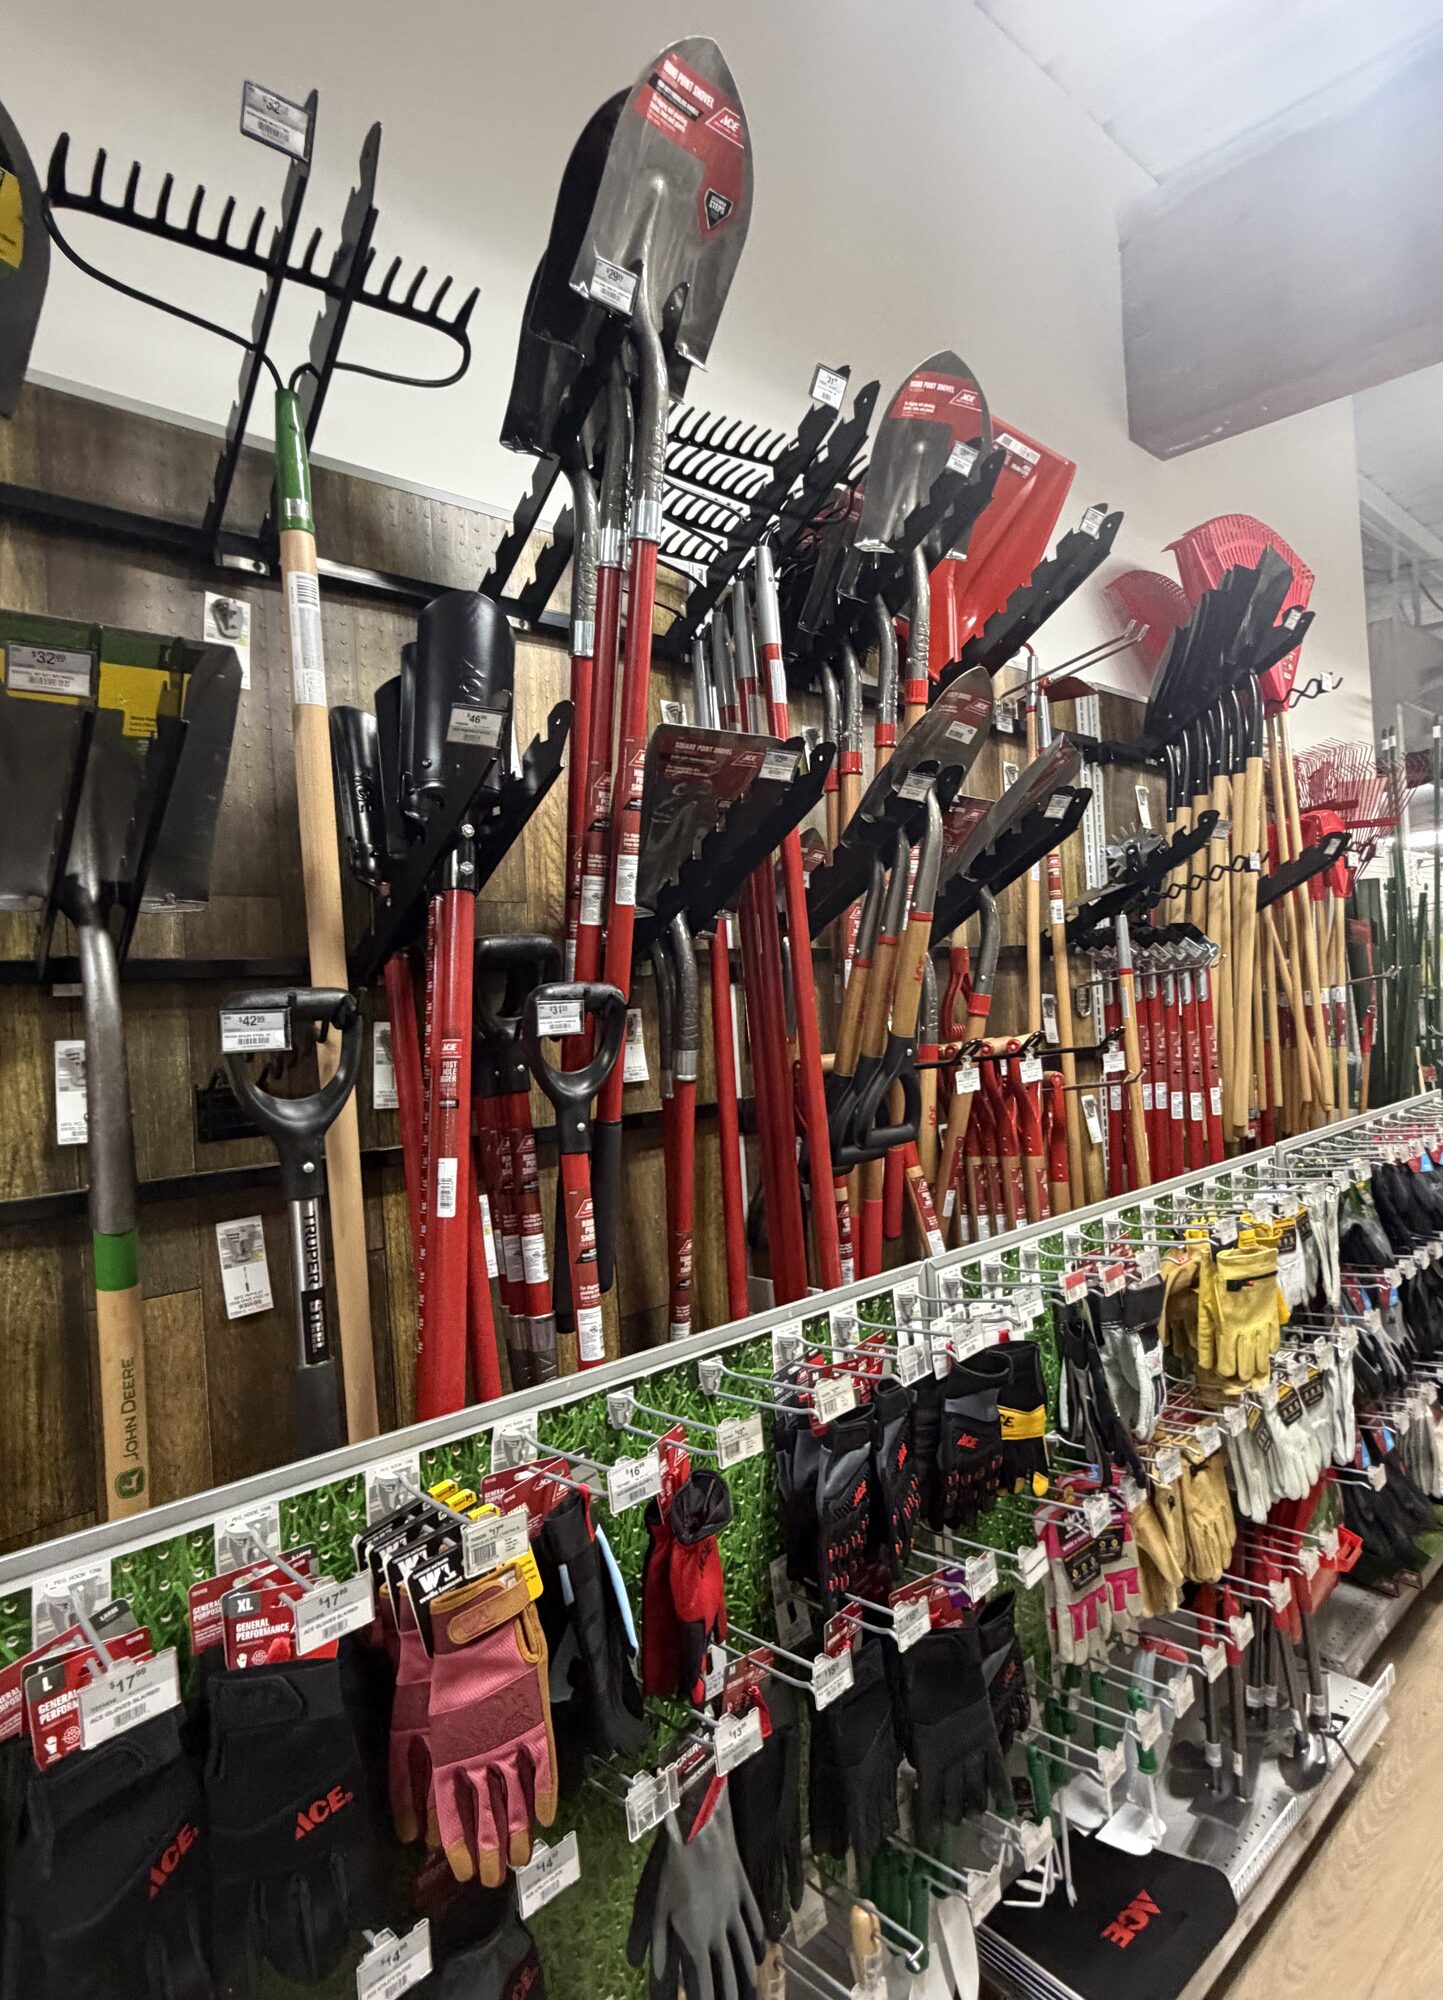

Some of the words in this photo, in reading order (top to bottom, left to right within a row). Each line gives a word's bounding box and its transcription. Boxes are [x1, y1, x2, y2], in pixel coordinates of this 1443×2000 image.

[719, 114, 741, 132] ACE
[442, 1043, 457, 1051] ACE
[304, 1214, 320, 1286] TRUPER
[309, 1299, 325, 1353] STEEL
[121, 1357, 137, 1414] DEERE
[124, 1415, 138, 1460] JOHN
[237, 1598, 254, 1613] XL
[236, 1618, 269, 1632] GENERAL
[236, 1623, 289, 1642] PERFORMANCE
[42, 1677, 52, 1692] L
[39, 1701, 79, 1725] PERFORM
[90, 1712, 104, 1724] ACE
[107, 1701, 132, 1717] GLOVES
[294, 1785, 347, 1841] ACE
[148, 1823, 195, 1898] ACE
[1101, 1889, 1160, 1948] ACE
